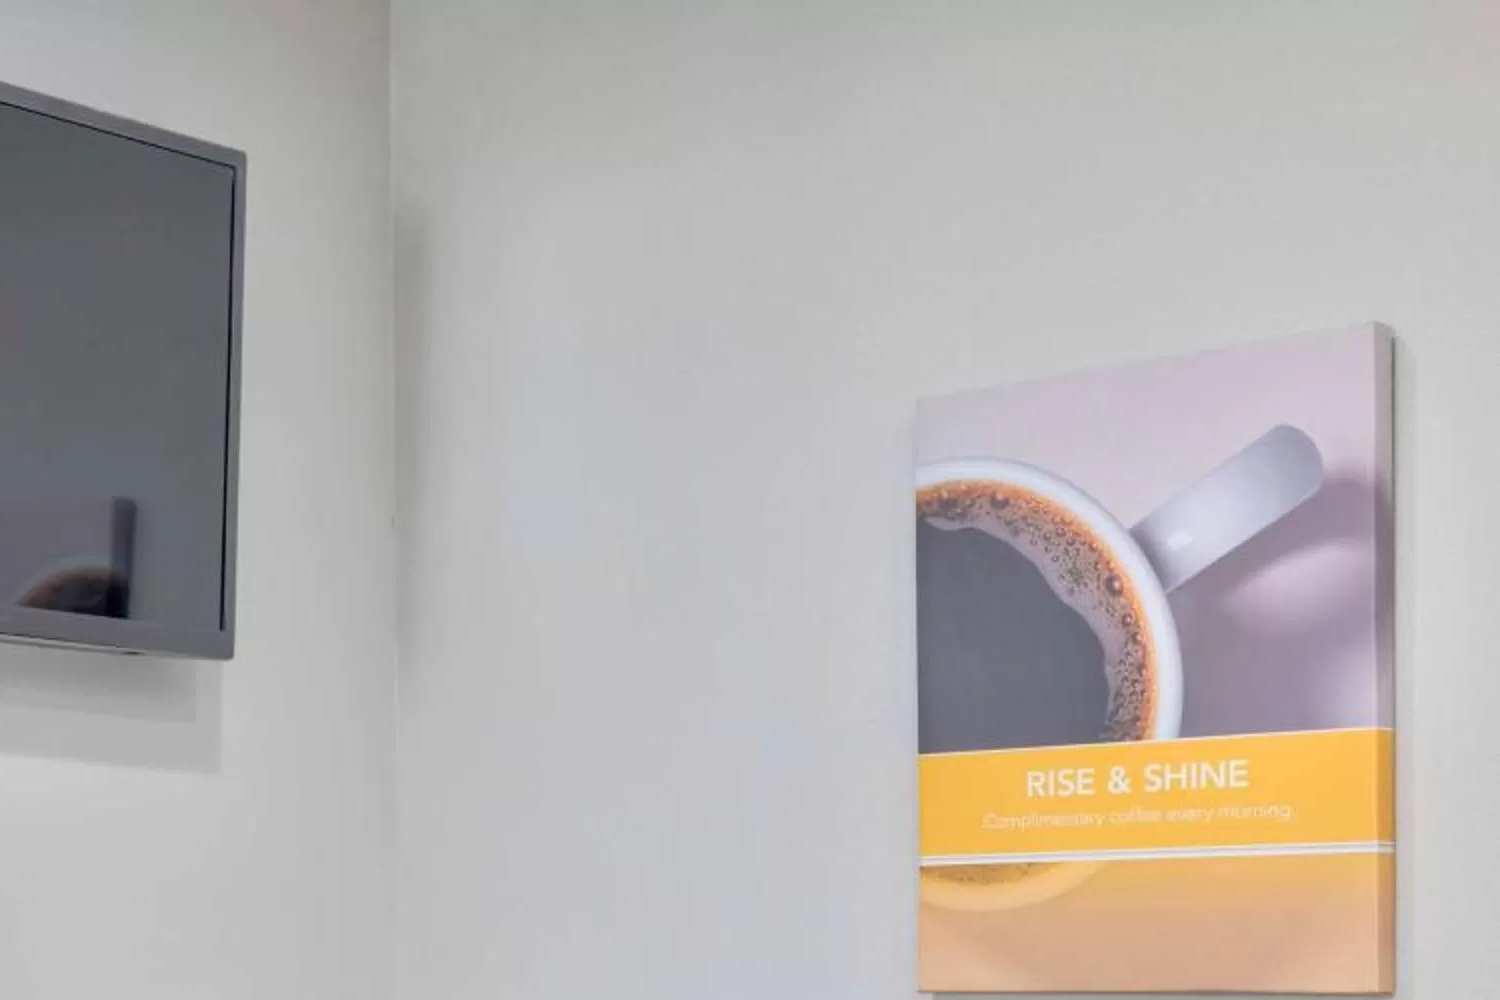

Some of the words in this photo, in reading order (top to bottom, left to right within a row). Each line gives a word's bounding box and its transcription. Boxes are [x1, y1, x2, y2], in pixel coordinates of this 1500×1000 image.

[1026, 766, 1095, 798] RISE
[1107, 764, 1132, 794] &
[1142, 758, 1250, 793] SHINE
